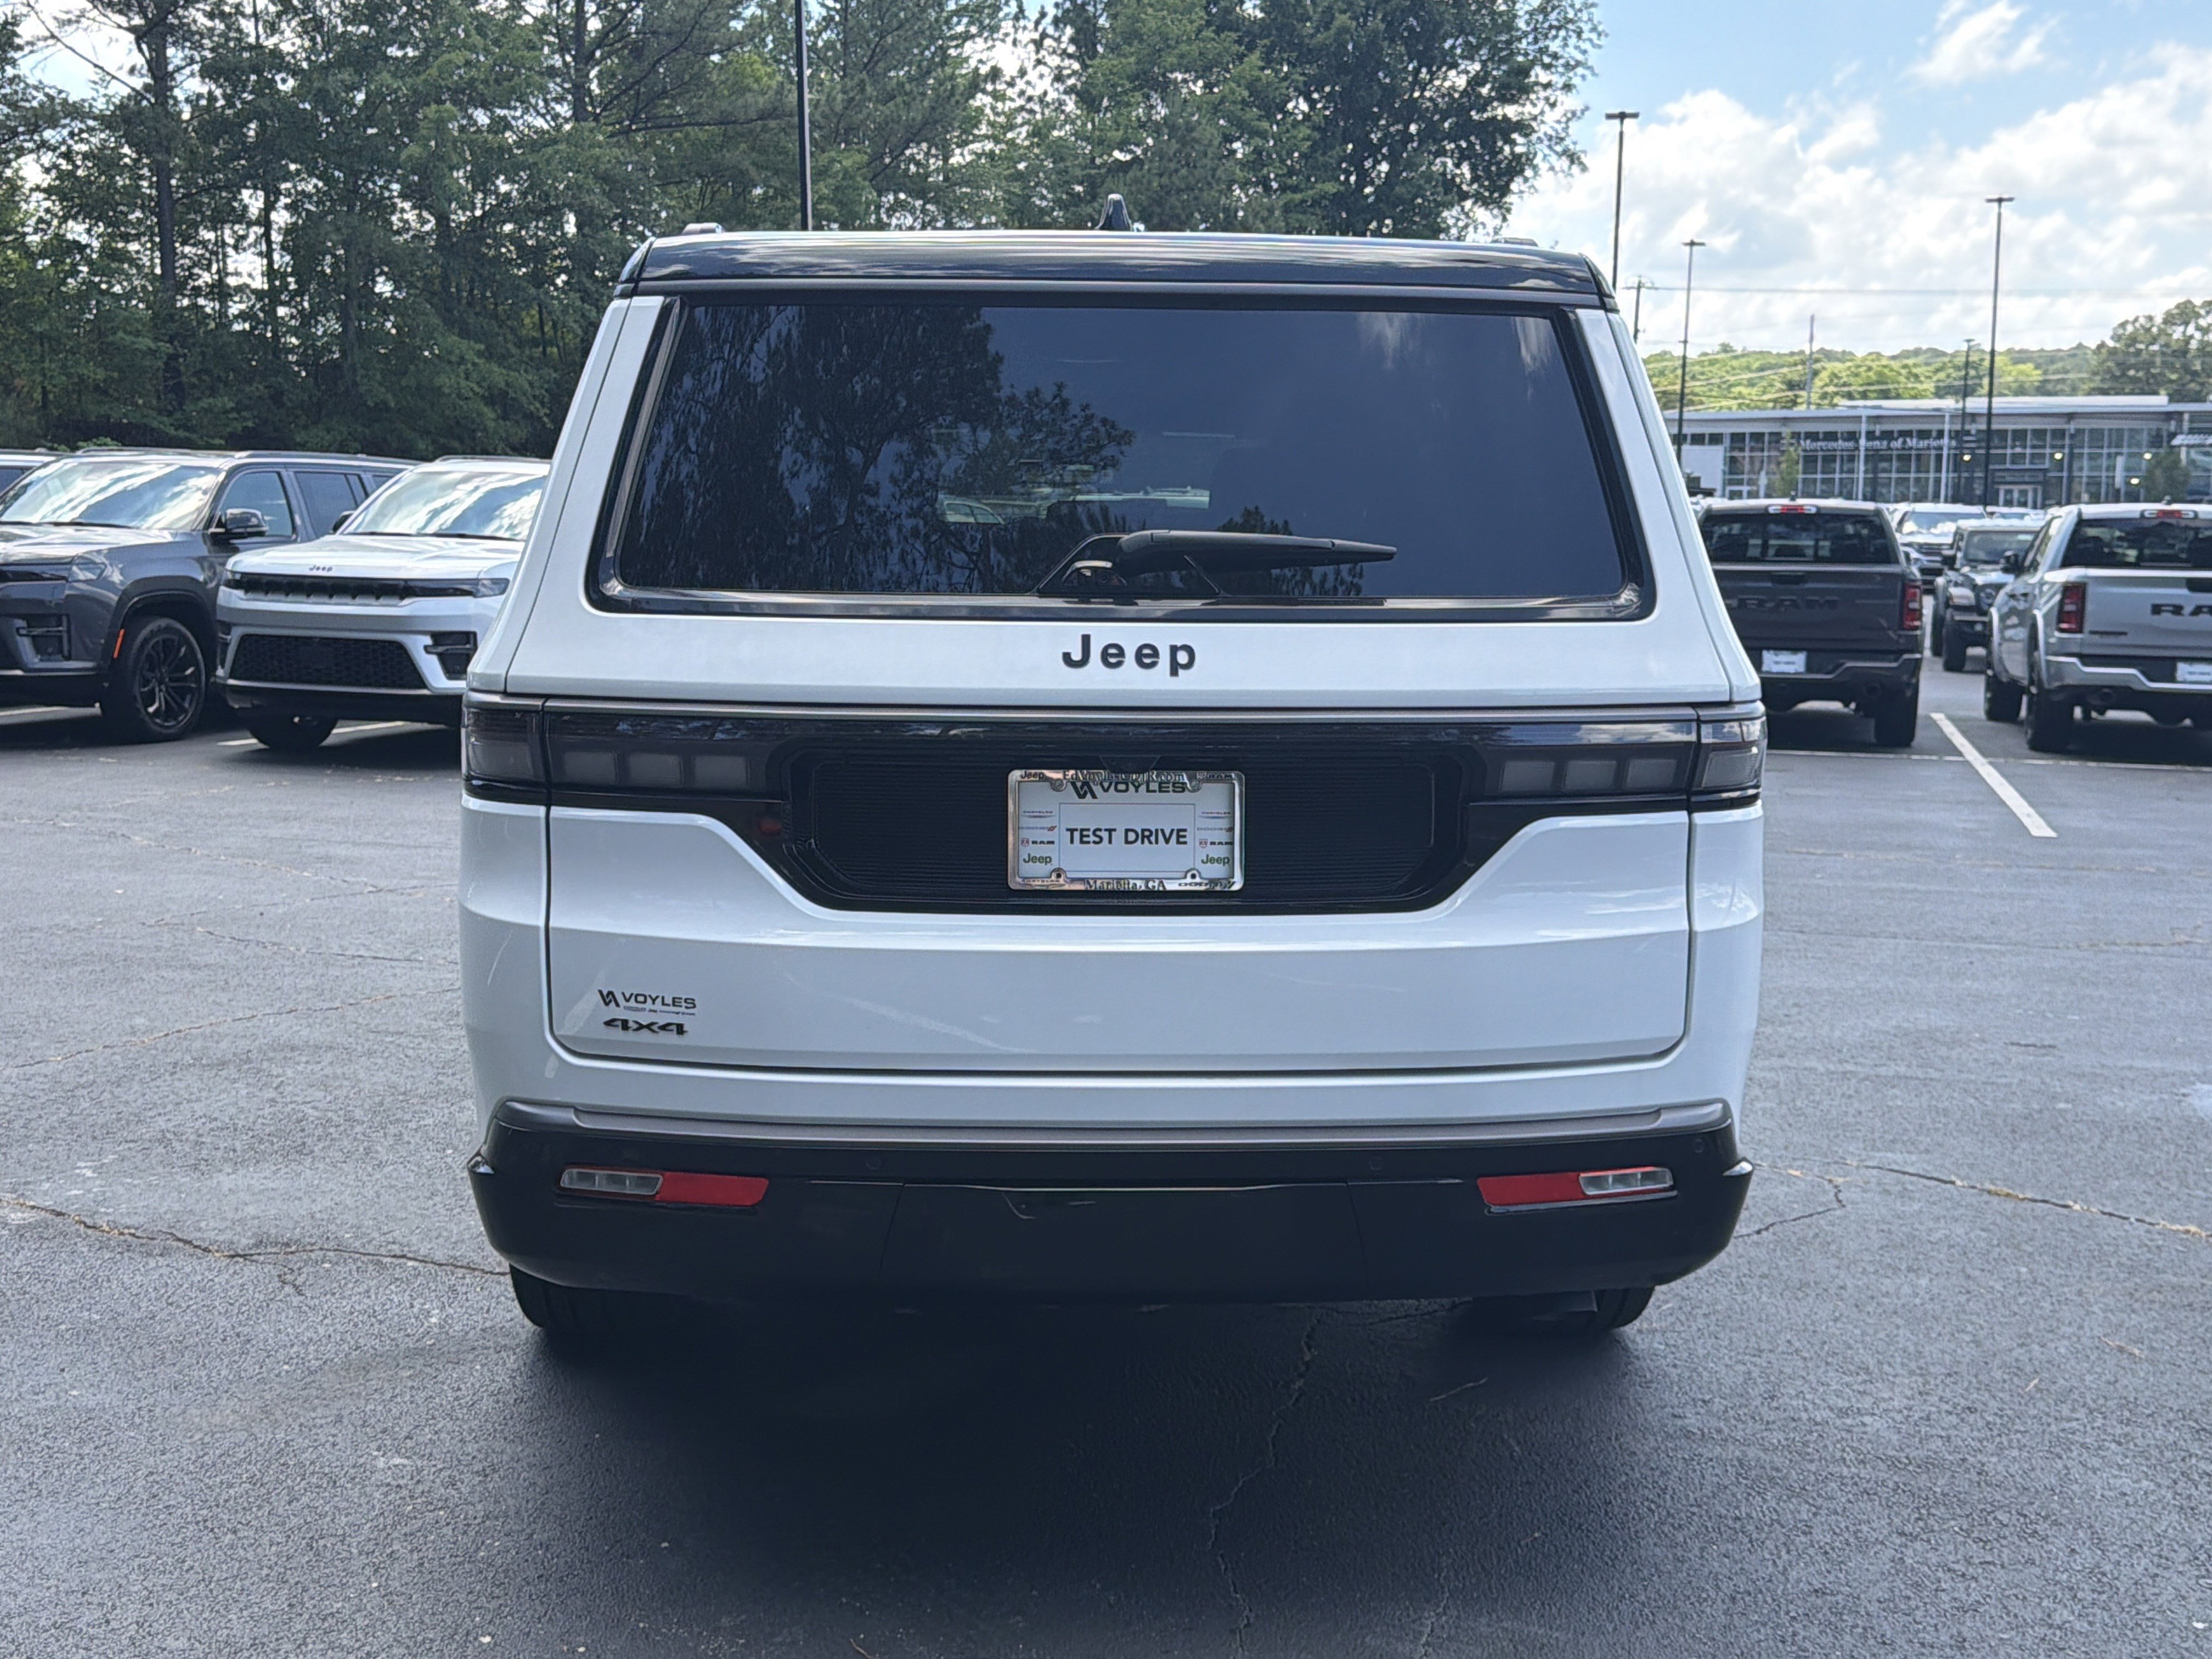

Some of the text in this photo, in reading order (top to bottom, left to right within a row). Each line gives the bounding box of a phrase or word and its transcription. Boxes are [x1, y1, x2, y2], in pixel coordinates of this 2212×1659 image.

[1889, 437, 1904, 450] of
[308, 564, 333, 572] Jeep
[1062, 634, 1196, 677] Jeep
[1020, 770, 1044, 780] Jeep
[1100, 780, 1186, 793] VOYLES
[1066, 828, 1188, 845] TEST DRIVE
[1023, 853, 1053, 865] Jeep
[1201, 854, 1231, 866] Jeep
[1144, 879, 1167, 891] GA
[621, 991, 696, 1009] VOYLES
